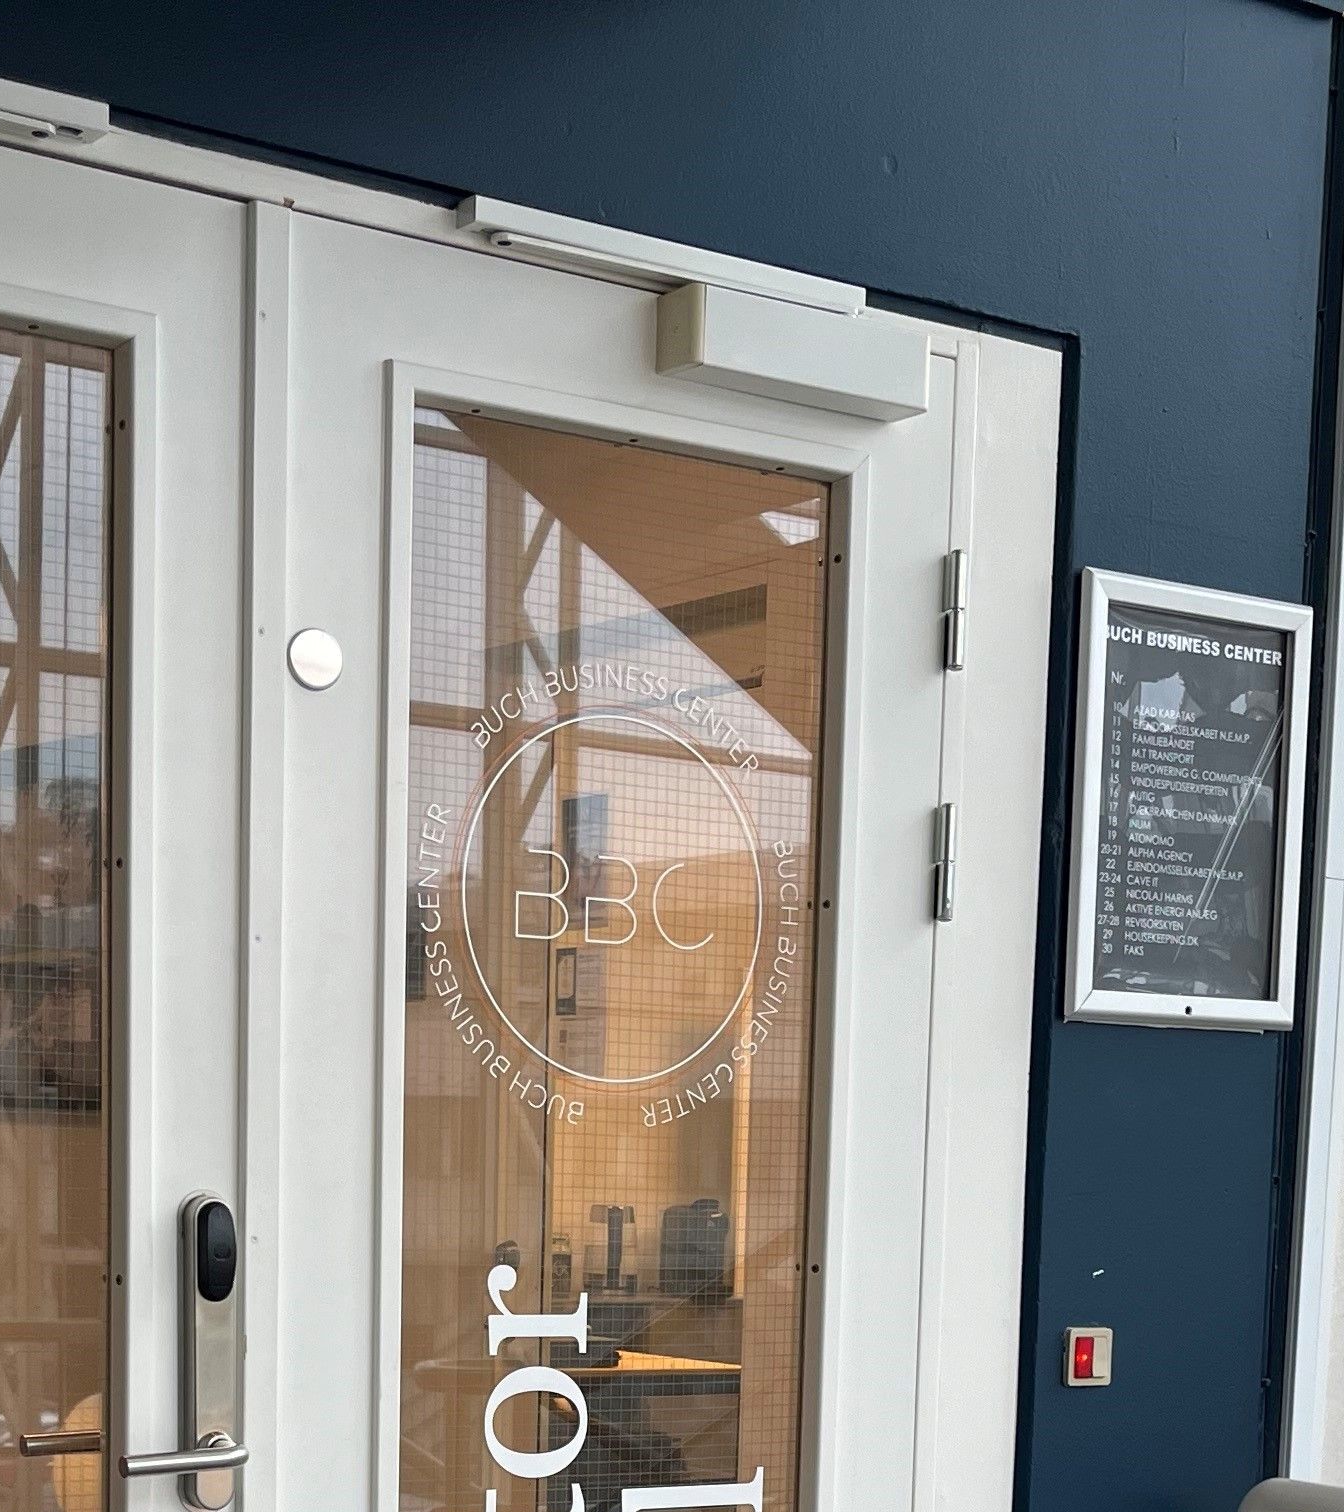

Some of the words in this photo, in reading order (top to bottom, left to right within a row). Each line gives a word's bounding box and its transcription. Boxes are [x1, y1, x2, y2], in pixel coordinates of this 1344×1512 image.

[1146, 631, 1221, 657] BUSINESS
[1224, 643, 1283, 666] CENTER
[1111, 671, 1127, 686] Nr.
[470, 684, 539, 750] BUCH
[545, 662, 669, 700] BUSINESS
[672, 687, 760, 774] CENTER
[1112, 715, 1122, 727] 11
[1111, 729, 1122, 742] 12
[1111, 744, 1121, 756] 13
[1147, 748, 1195, 765] TRANSPORT
[1110, 758, 1120, 769] 14
[1131, 761, 1190, 779] EMPOWERING
[1109, 772, 1120, 784] 15
[1109, 784, 1121, 798] 16
[1108, 801, 1119, 812] 17
[1108, 815, 1118, 827] 18
[1107, 829, 1117, 841] 19
[1127, 846, 1156, 859] ALPHA
[1156, 849, 1194, 863] AGENCY
[419, 802, 453, 931] CENTER
[1105, 858, 1116, 870] 22
[773, 838, 800, 929] BUCH
[514, 848, 715, 951] BBC
[1104, 886, 1115, 898] 25
[1103, 900, 1114, 912] 26
[1102, 928, 1113, 940] 29
[1101, 942, 1113, 954] 30
[732, 931, 799, 1069] BUSINESS
[424, 938, 511, 1080] BUSINESS
[509, 1070, 585, 1126] BUCH
[640, 1061, 735, 1128] CENTER
